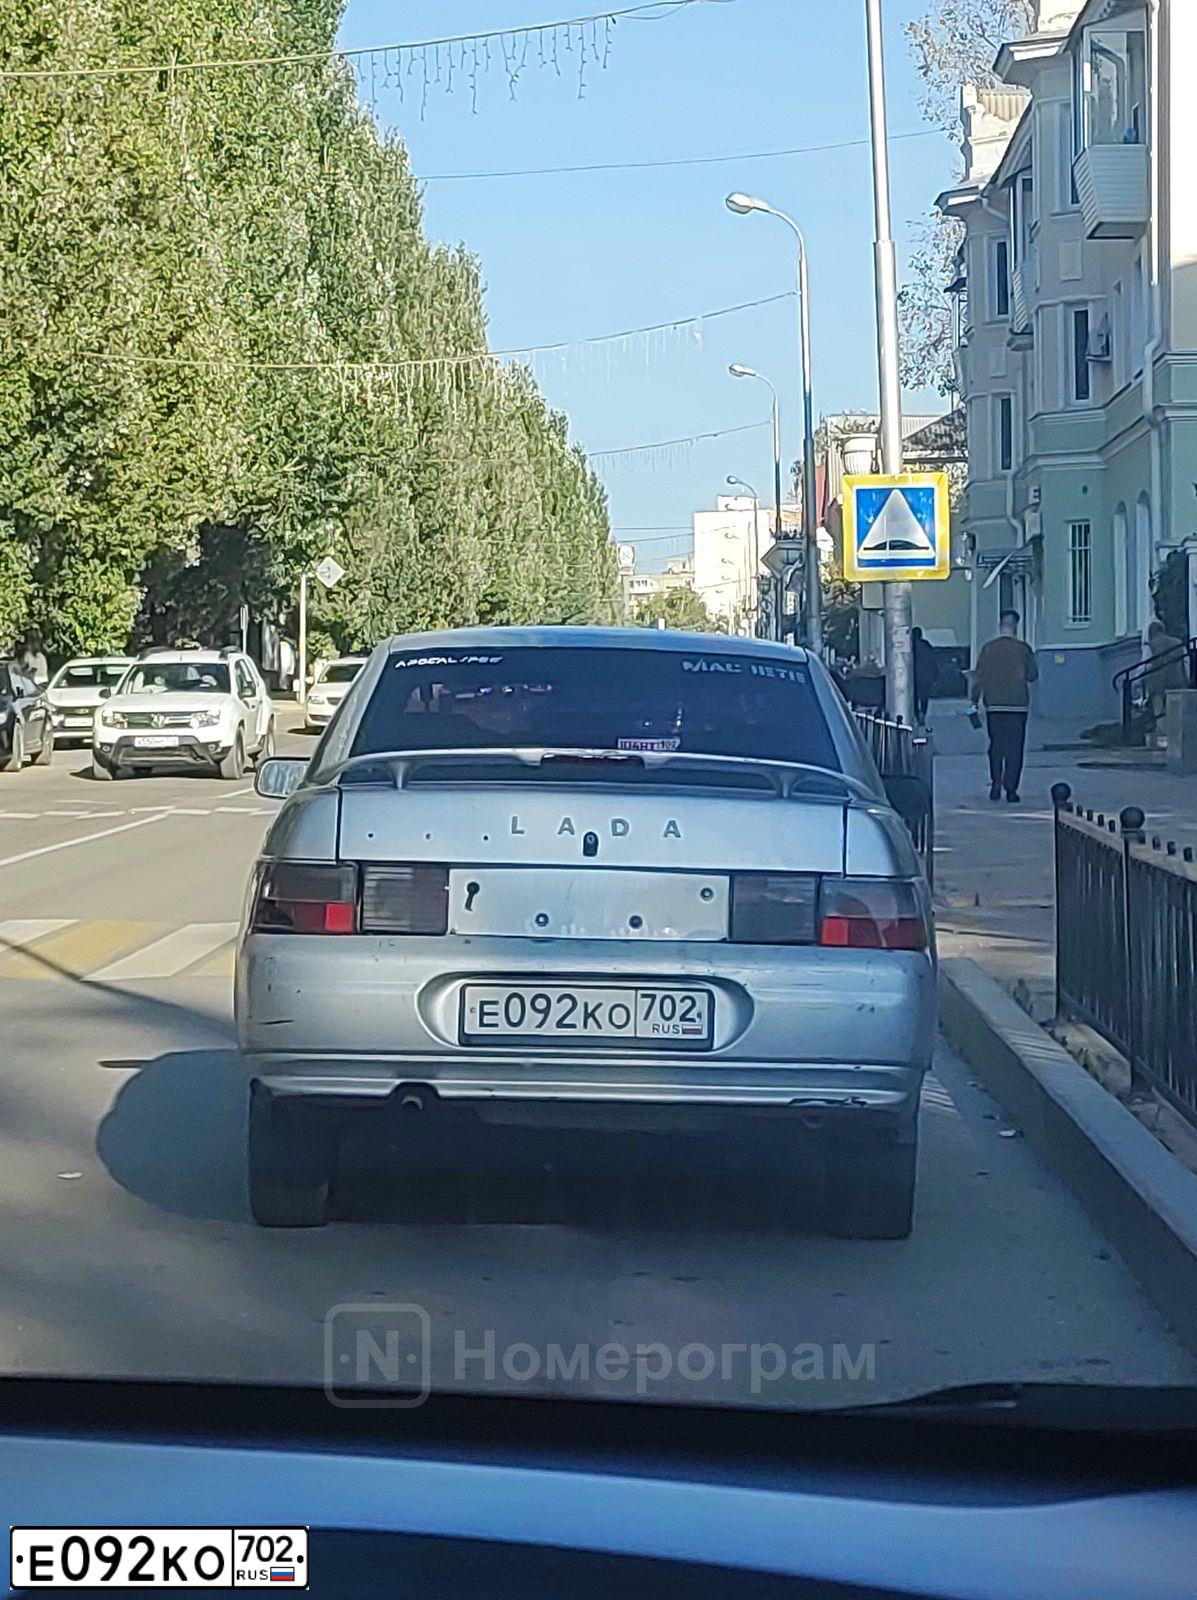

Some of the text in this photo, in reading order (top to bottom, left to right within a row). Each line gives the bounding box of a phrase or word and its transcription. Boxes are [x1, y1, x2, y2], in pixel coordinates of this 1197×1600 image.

[511, 816, 682, 839] LADA
[478, 992, 697, 1030] Е092КО 702
[652, 1024, 681, 1035] RUS
